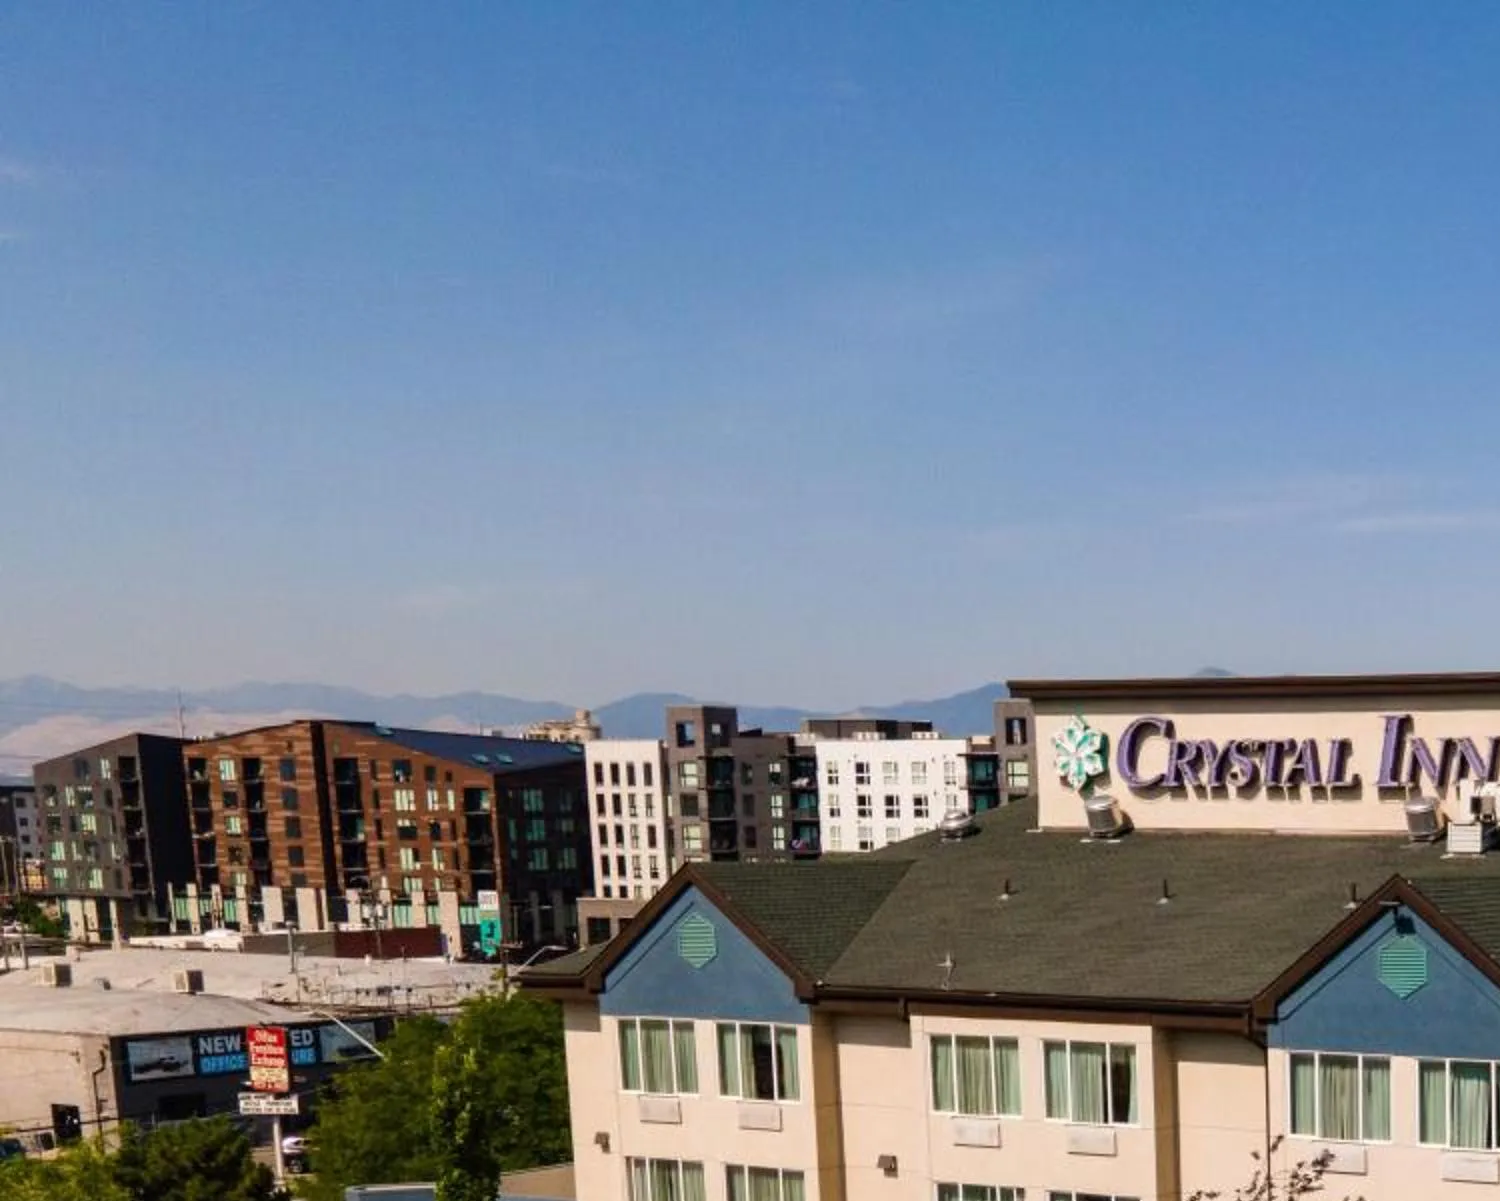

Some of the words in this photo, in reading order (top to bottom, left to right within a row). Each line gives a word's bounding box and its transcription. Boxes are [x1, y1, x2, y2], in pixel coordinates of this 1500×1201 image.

[1117, 715, 1357, 788] CRYSTAL
[199, 1033, 241, 1055] NEW
[291, 1029, 313, 1046] ED
[201, 1055, 247, 1073] OFFICE
